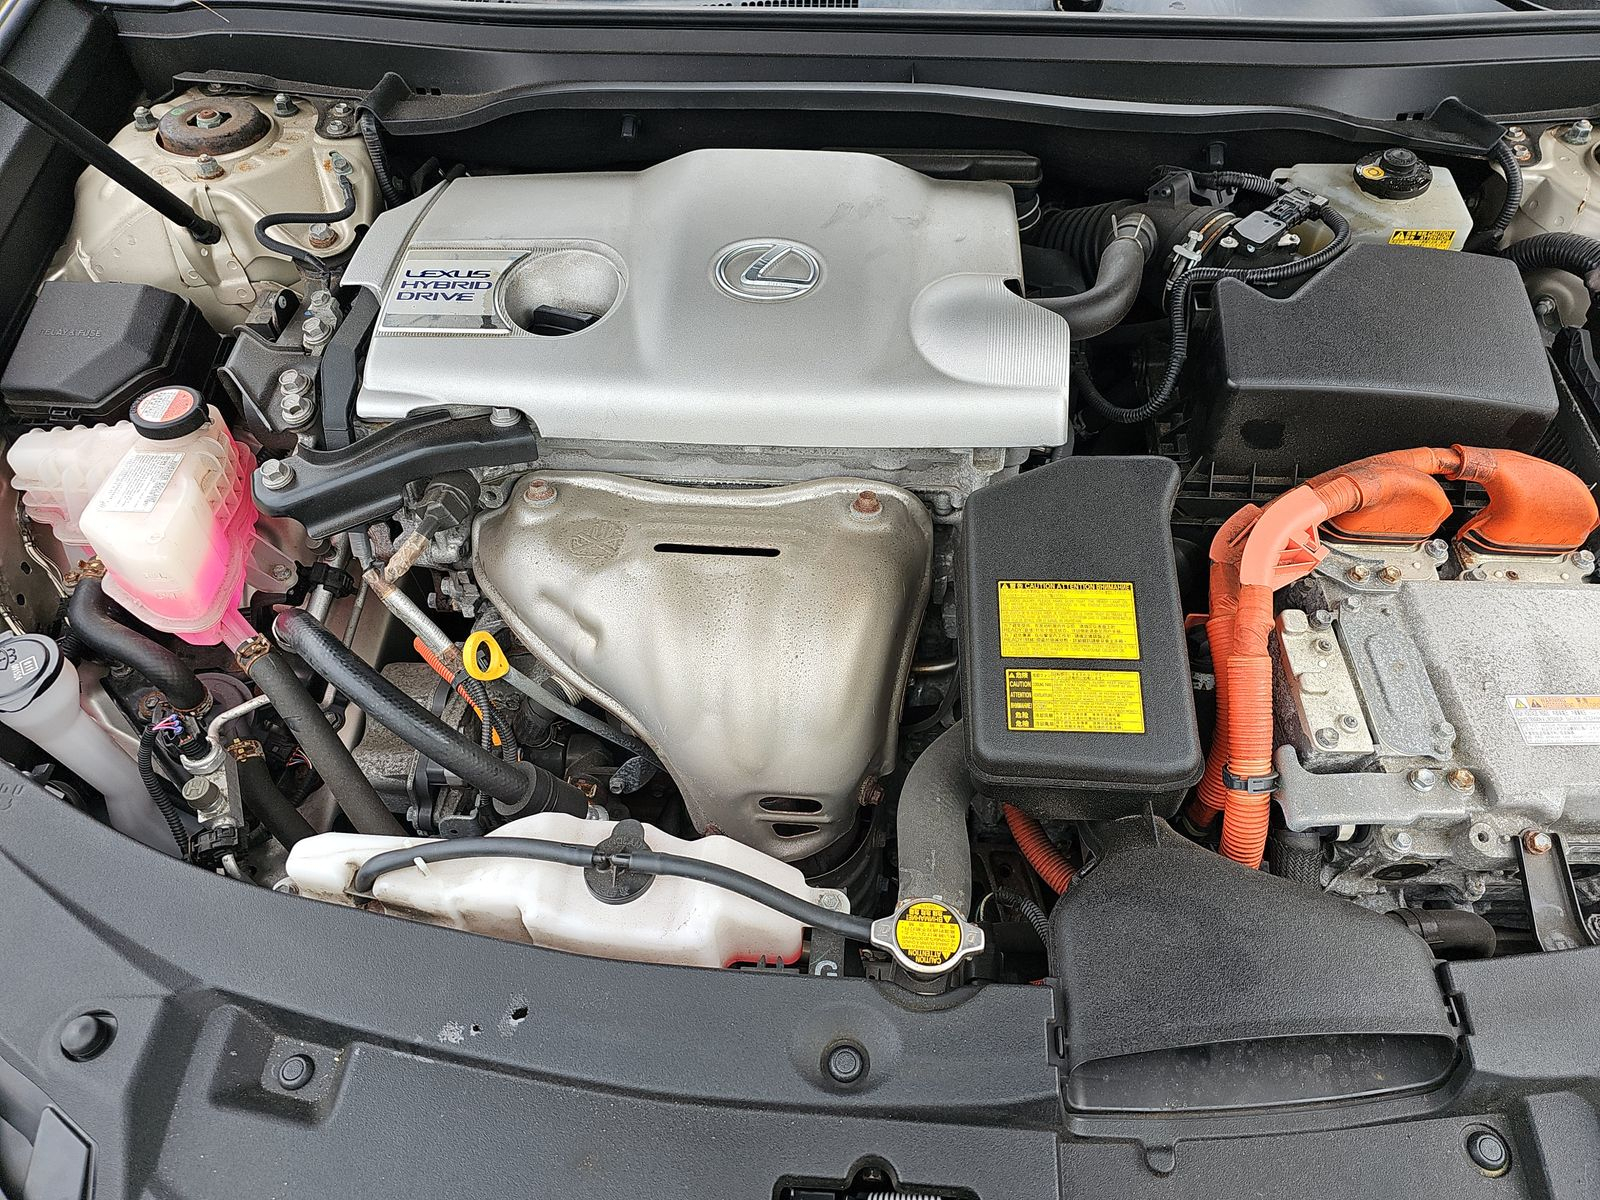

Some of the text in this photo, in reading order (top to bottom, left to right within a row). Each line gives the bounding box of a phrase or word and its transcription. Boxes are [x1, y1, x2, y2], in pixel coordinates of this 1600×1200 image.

[405, 269, 491, 278] LEXUS
[400, 280, 493, 290] HYBRID
[396, 291, 475, 301] DRIVE
[78, 329, 101, 338] FUSE
[908, 949, 942, 957] ATTENTION
[915, 955, 942, 964] CAUTION
